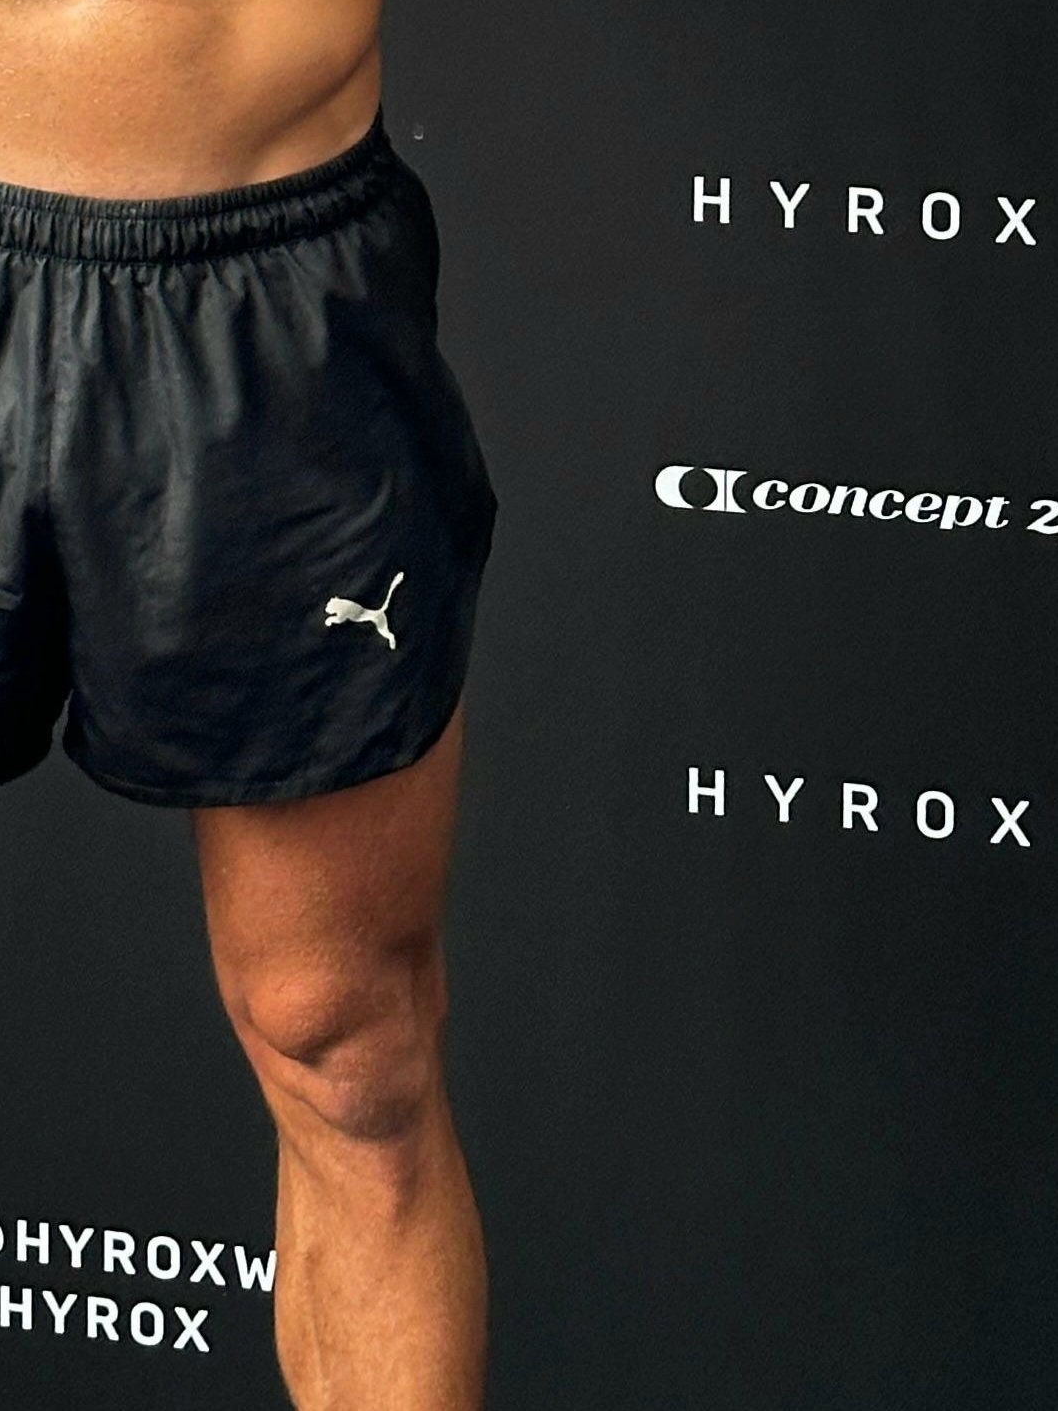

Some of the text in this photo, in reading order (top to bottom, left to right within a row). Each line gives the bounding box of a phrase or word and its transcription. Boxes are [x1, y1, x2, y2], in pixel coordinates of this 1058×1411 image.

[693, 175, 1037, 246] HYROX
[752, 479, 1058, 535] concept 2
[688, 767, 1031, 847] HYROX
